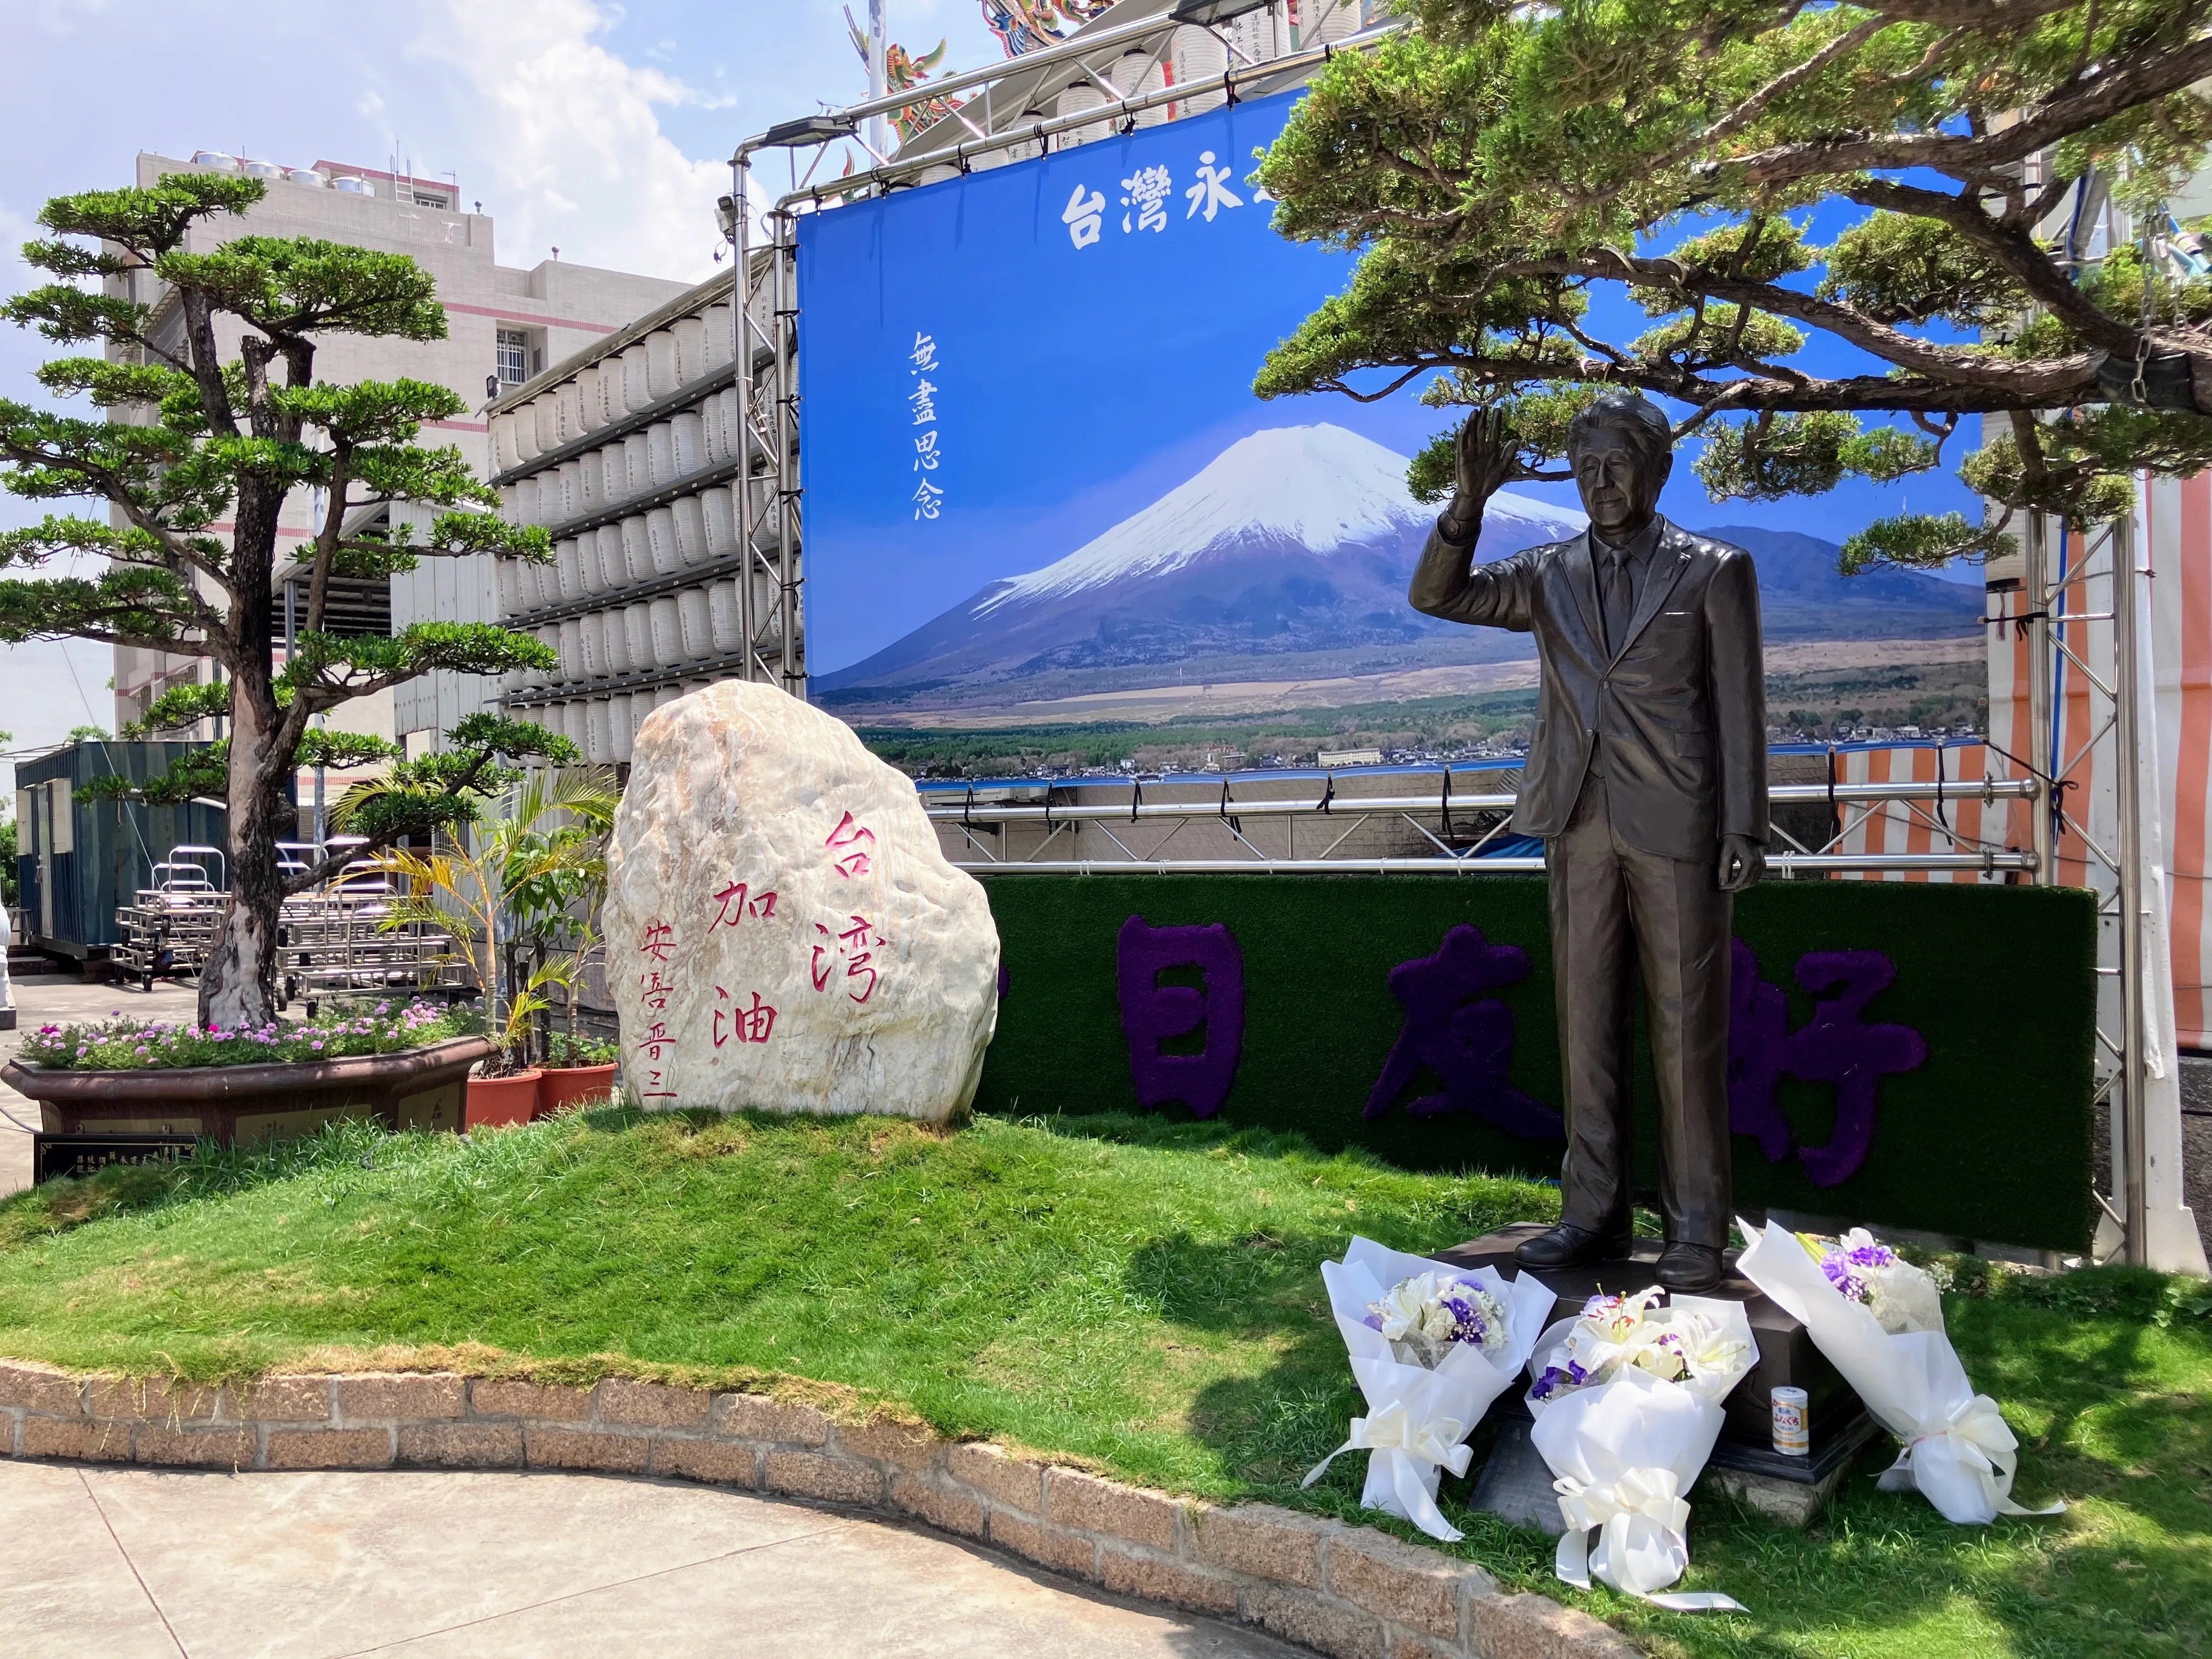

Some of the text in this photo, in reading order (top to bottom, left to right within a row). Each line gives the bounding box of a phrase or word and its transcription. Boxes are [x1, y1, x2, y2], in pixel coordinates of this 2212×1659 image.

[1061, 150, 1284, 250] 台灣永
[908, 331, 944, 521] 無盡思念
[639, 919, 678, 1098] 安倍晋三
[707, 881, 778, 1049] 加油
[997, 915, 1929, 1188] 日友好
